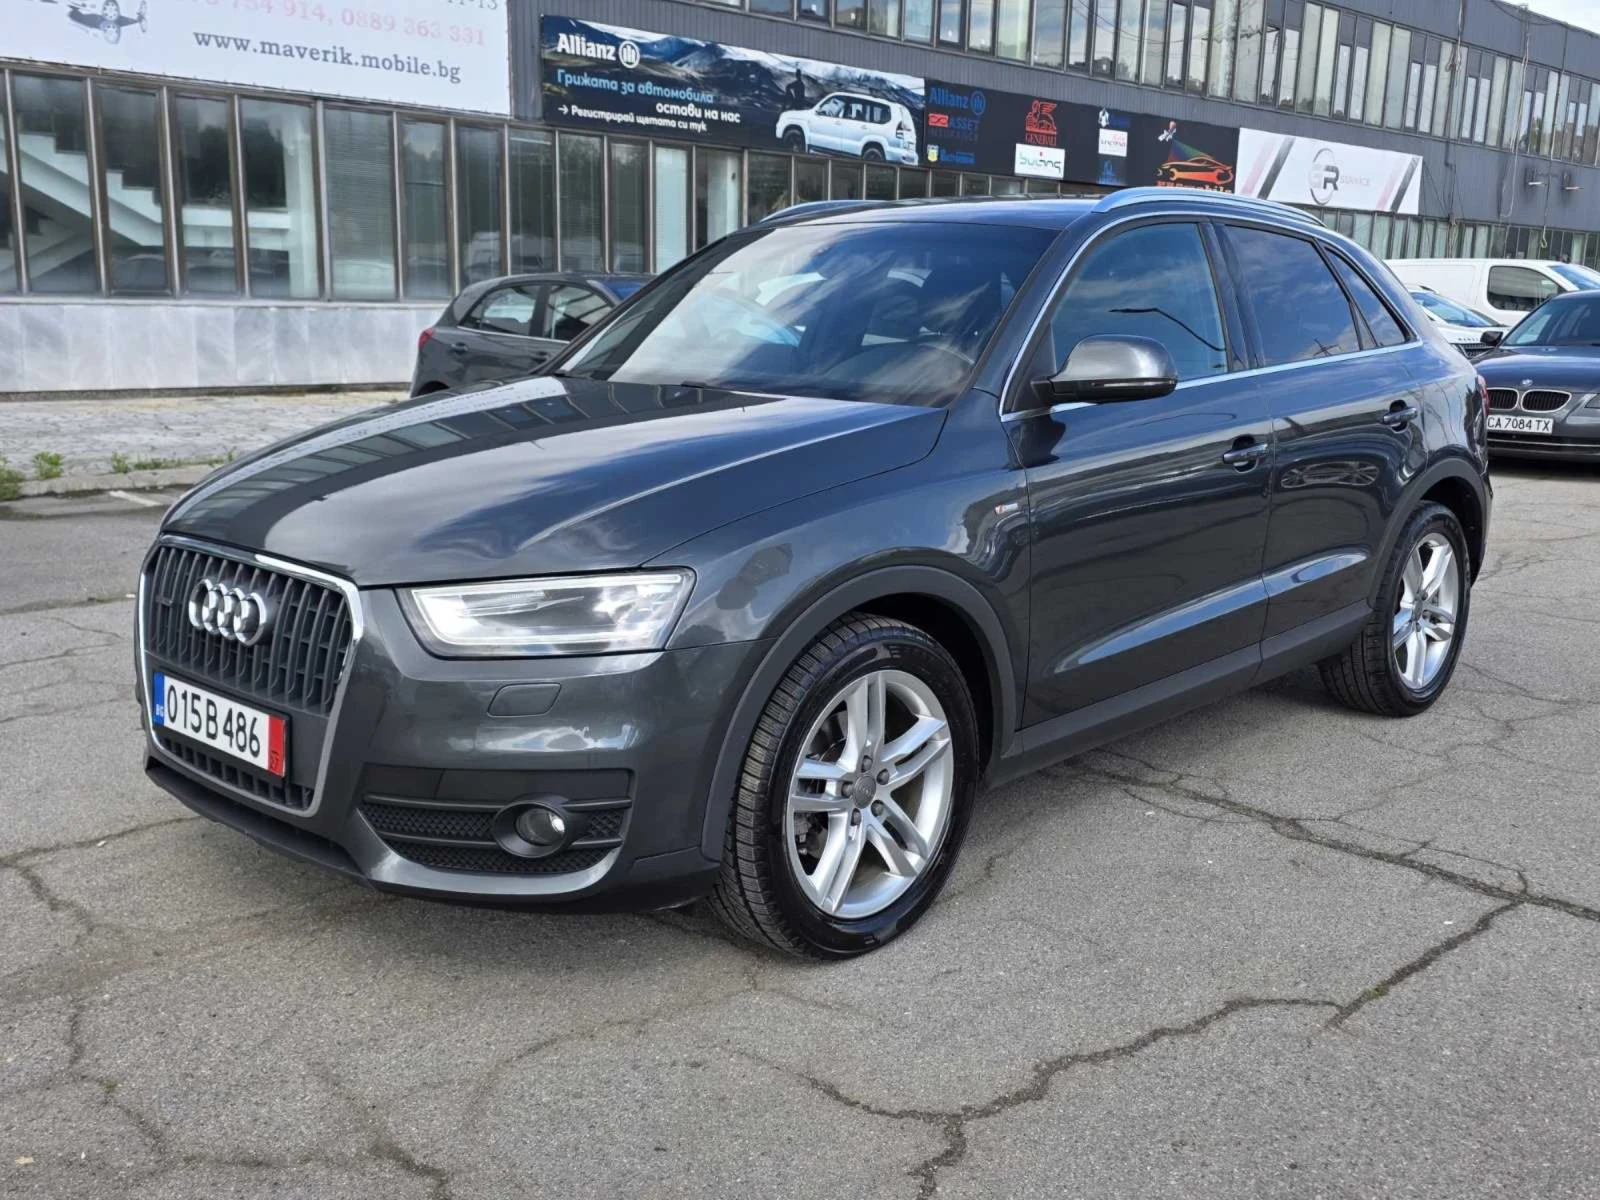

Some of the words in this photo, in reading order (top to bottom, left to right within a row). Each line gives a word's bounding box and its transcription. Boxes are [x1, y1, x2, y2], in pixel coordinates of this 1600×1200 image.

[341, 7, 396, 31] 0889
[403, 17, 441, 39] 363
[450, 24, 486, 46] 331
[192, 31, 461, 84] www.maverik.mobile.bg
[557, 33, 616, 61] Allianz
[557, 68, 619, 91] Грижата
[620, 82, 635, 95] за
[637, 81, 714, 103] автомобила
[928, 87, 969, 110] Allianz
[571, 105, 635, 123] Регистрирай
[635, 115, 677, 128] щетата
[677, 120, 688, 129] си
[689, 120, 708, 133] тук
[655, 102, 702, 118] остави
[704, 109, 719, 120] на
[720, 111, 741, 123] нас
[949, 116, 980, 131] ASSET
[1487, 416, 1501, 429] CA
[1504, 417, 1532, 431] 7084
[1535, 418, 1550, 432] TX
[166, 684, 261, 759] 015B486
